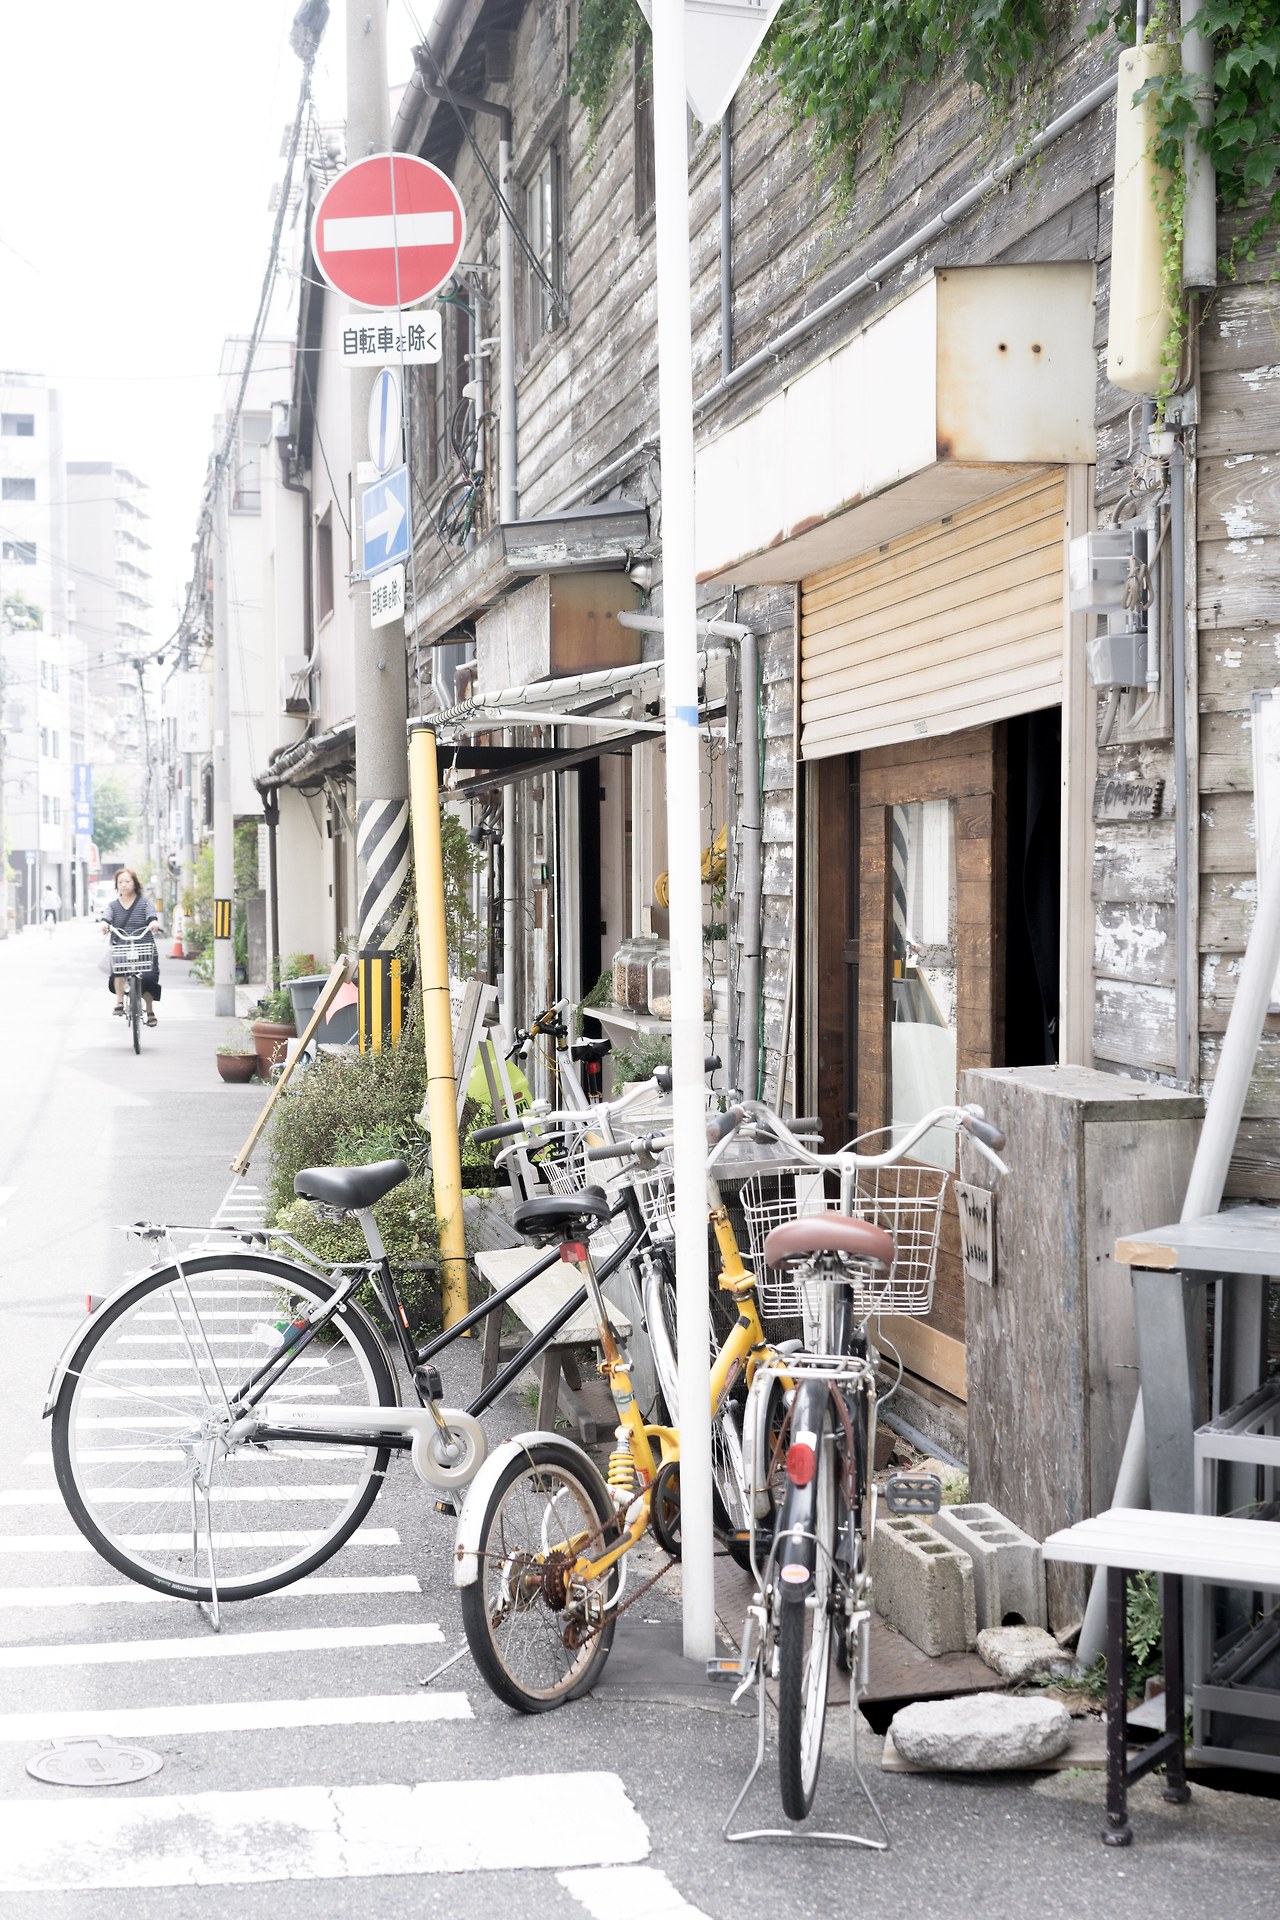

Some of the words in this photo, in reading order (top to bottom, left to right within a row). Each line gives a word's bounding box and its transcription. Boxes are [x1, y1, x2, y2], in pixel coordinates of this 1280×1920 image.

[343, 324, 437, 355] 自転車を除く
